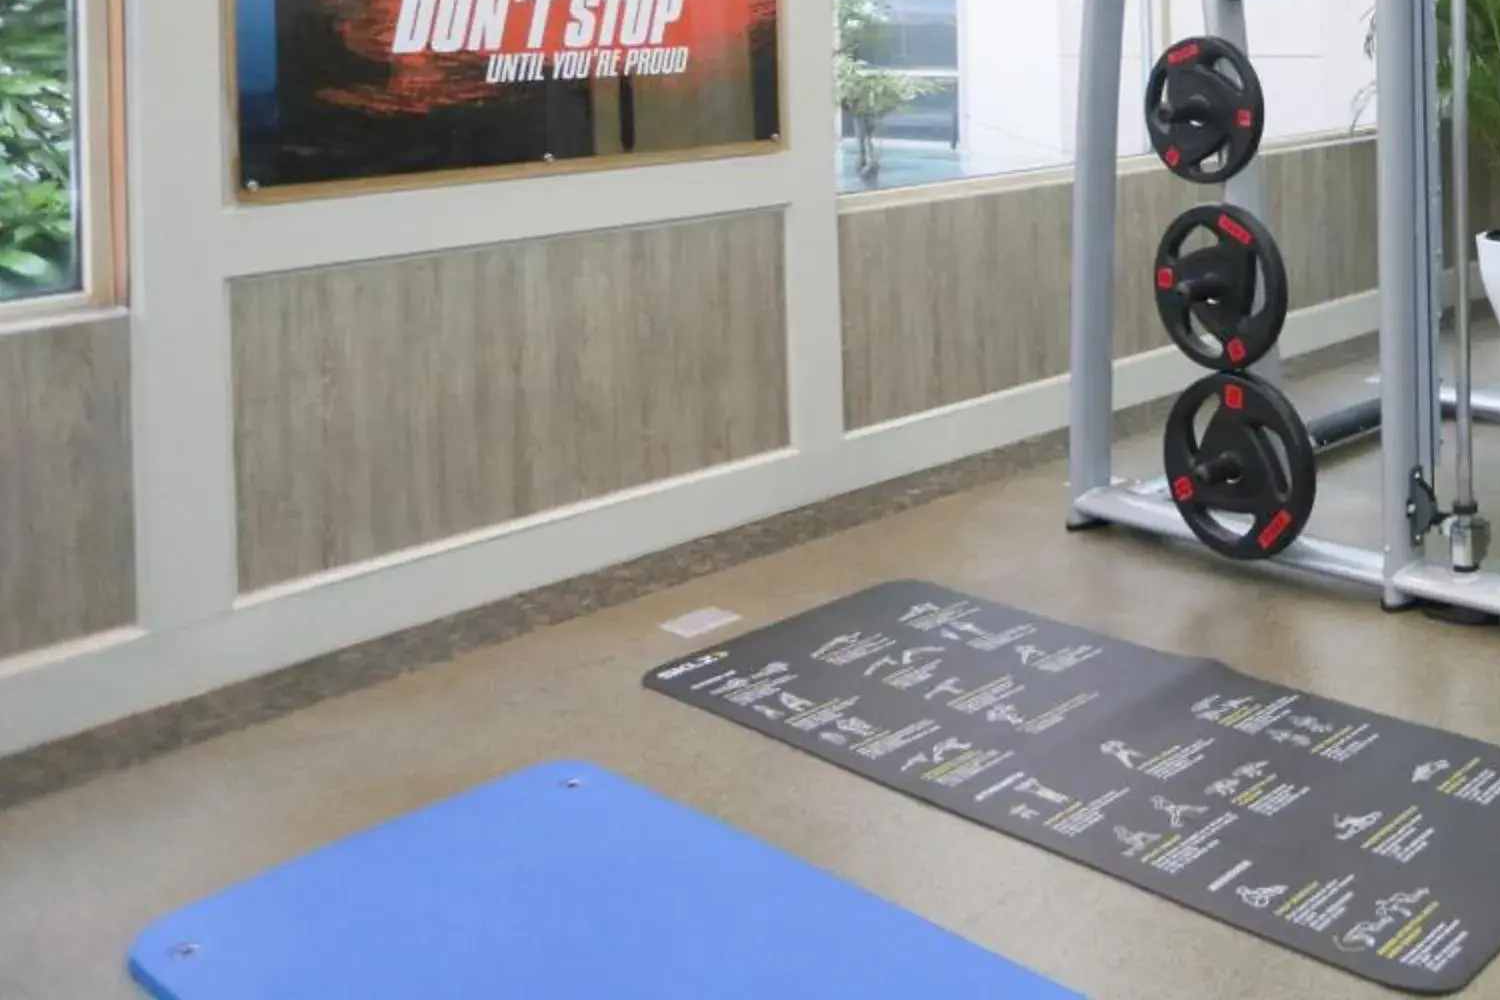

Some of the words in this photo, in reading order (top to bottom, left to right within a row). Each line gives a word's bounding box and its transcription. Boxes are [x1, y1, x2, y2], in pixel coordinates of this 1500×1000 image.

[486, 52, 545, 83] UNTIL
[552, 49, 622, 80] YOU'RE
[624, 47, 689, 75] PROUD
